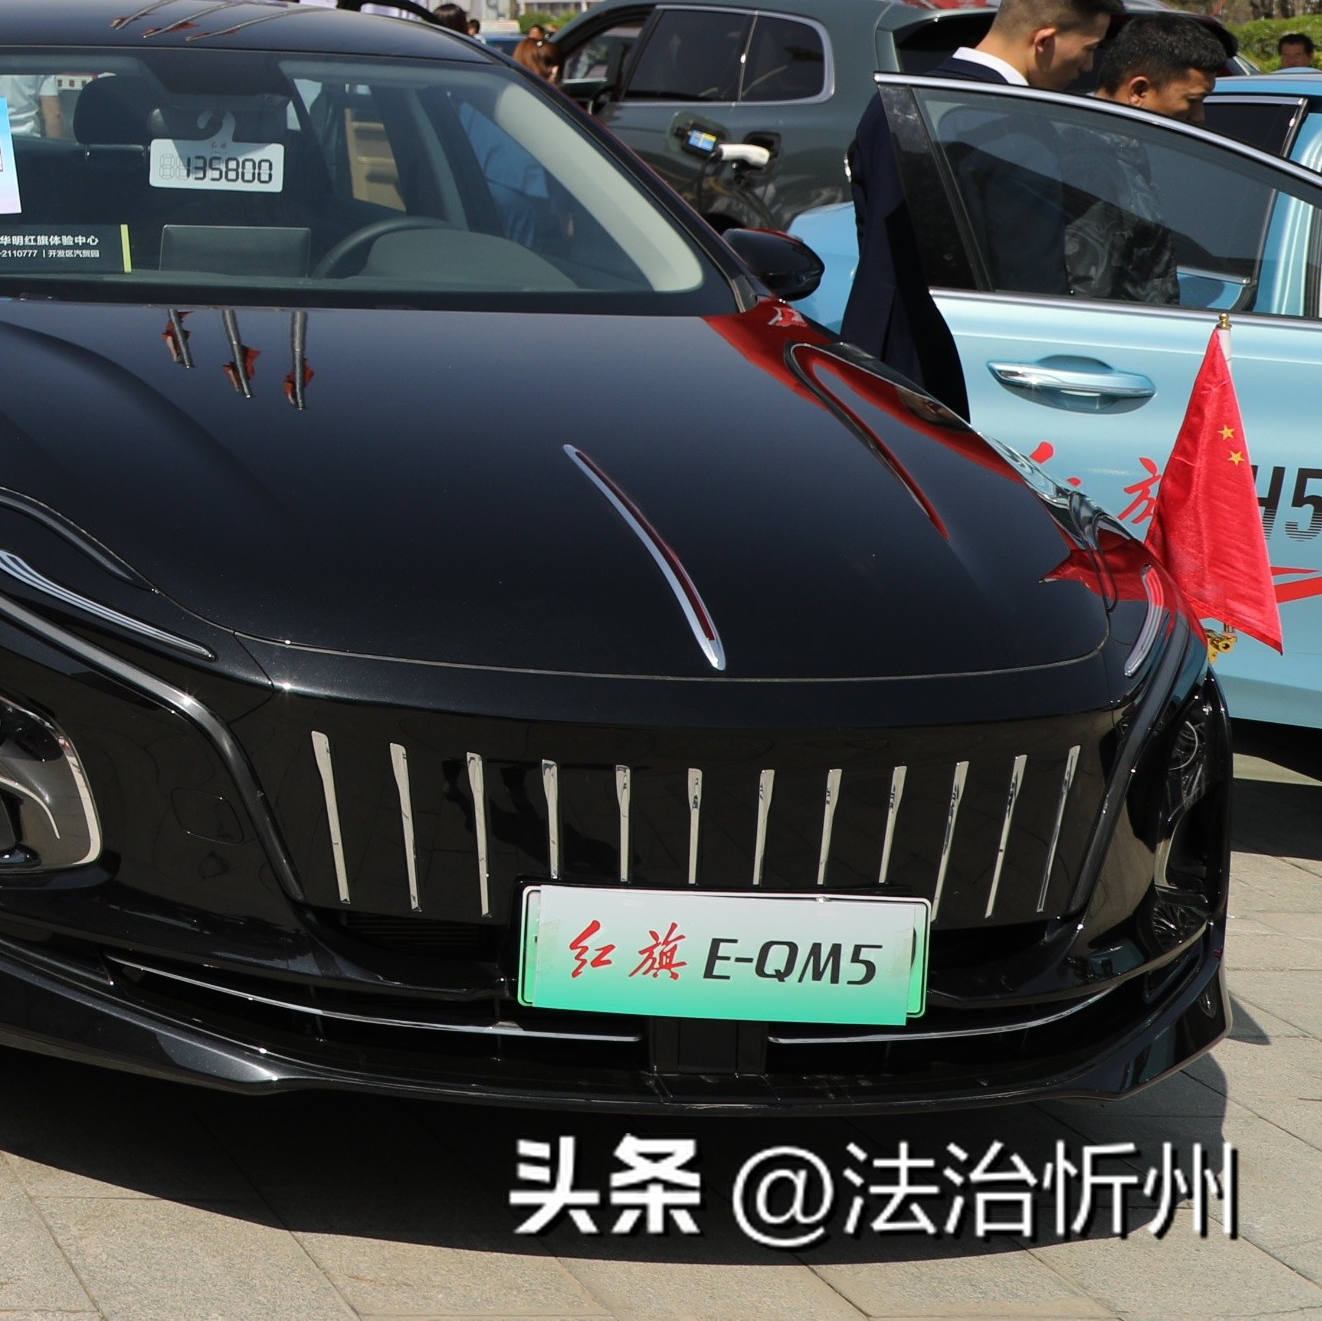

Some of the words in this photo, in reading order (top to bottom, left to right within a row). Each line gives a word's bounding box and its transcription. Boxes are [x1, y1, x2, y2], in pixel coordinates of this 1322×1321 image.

[184, 155, 274, 185] 135800
[569, 920, 688, 981] 红旗
[703, 938, 883, 986] E-QM5
